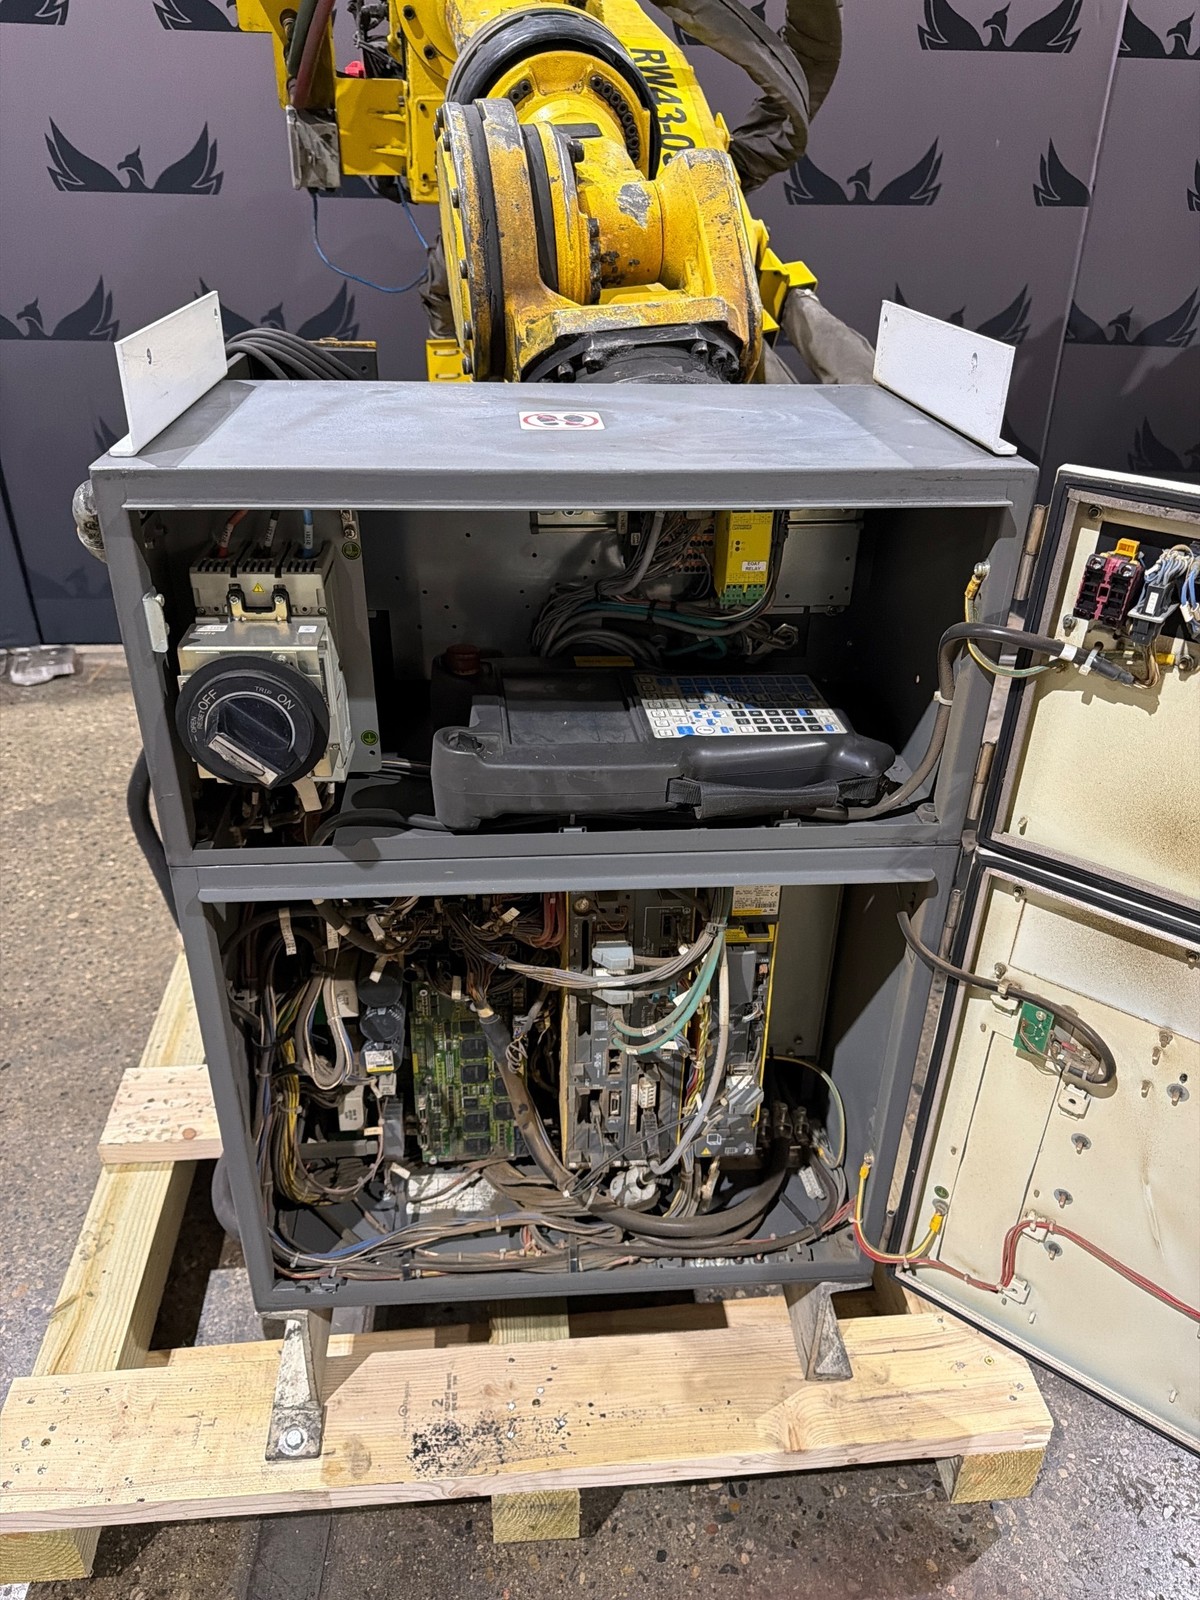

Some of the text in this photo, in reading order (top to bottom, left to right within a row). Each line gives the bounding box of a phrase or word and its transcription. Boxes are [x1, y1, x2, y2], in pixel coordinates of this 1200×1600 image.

[254, 685, 273, 695] TRIP
[197, 688, 217, 711] OFF
[276, 693, 296, 711] ON
[190, 715, 198, 734] OPEN
